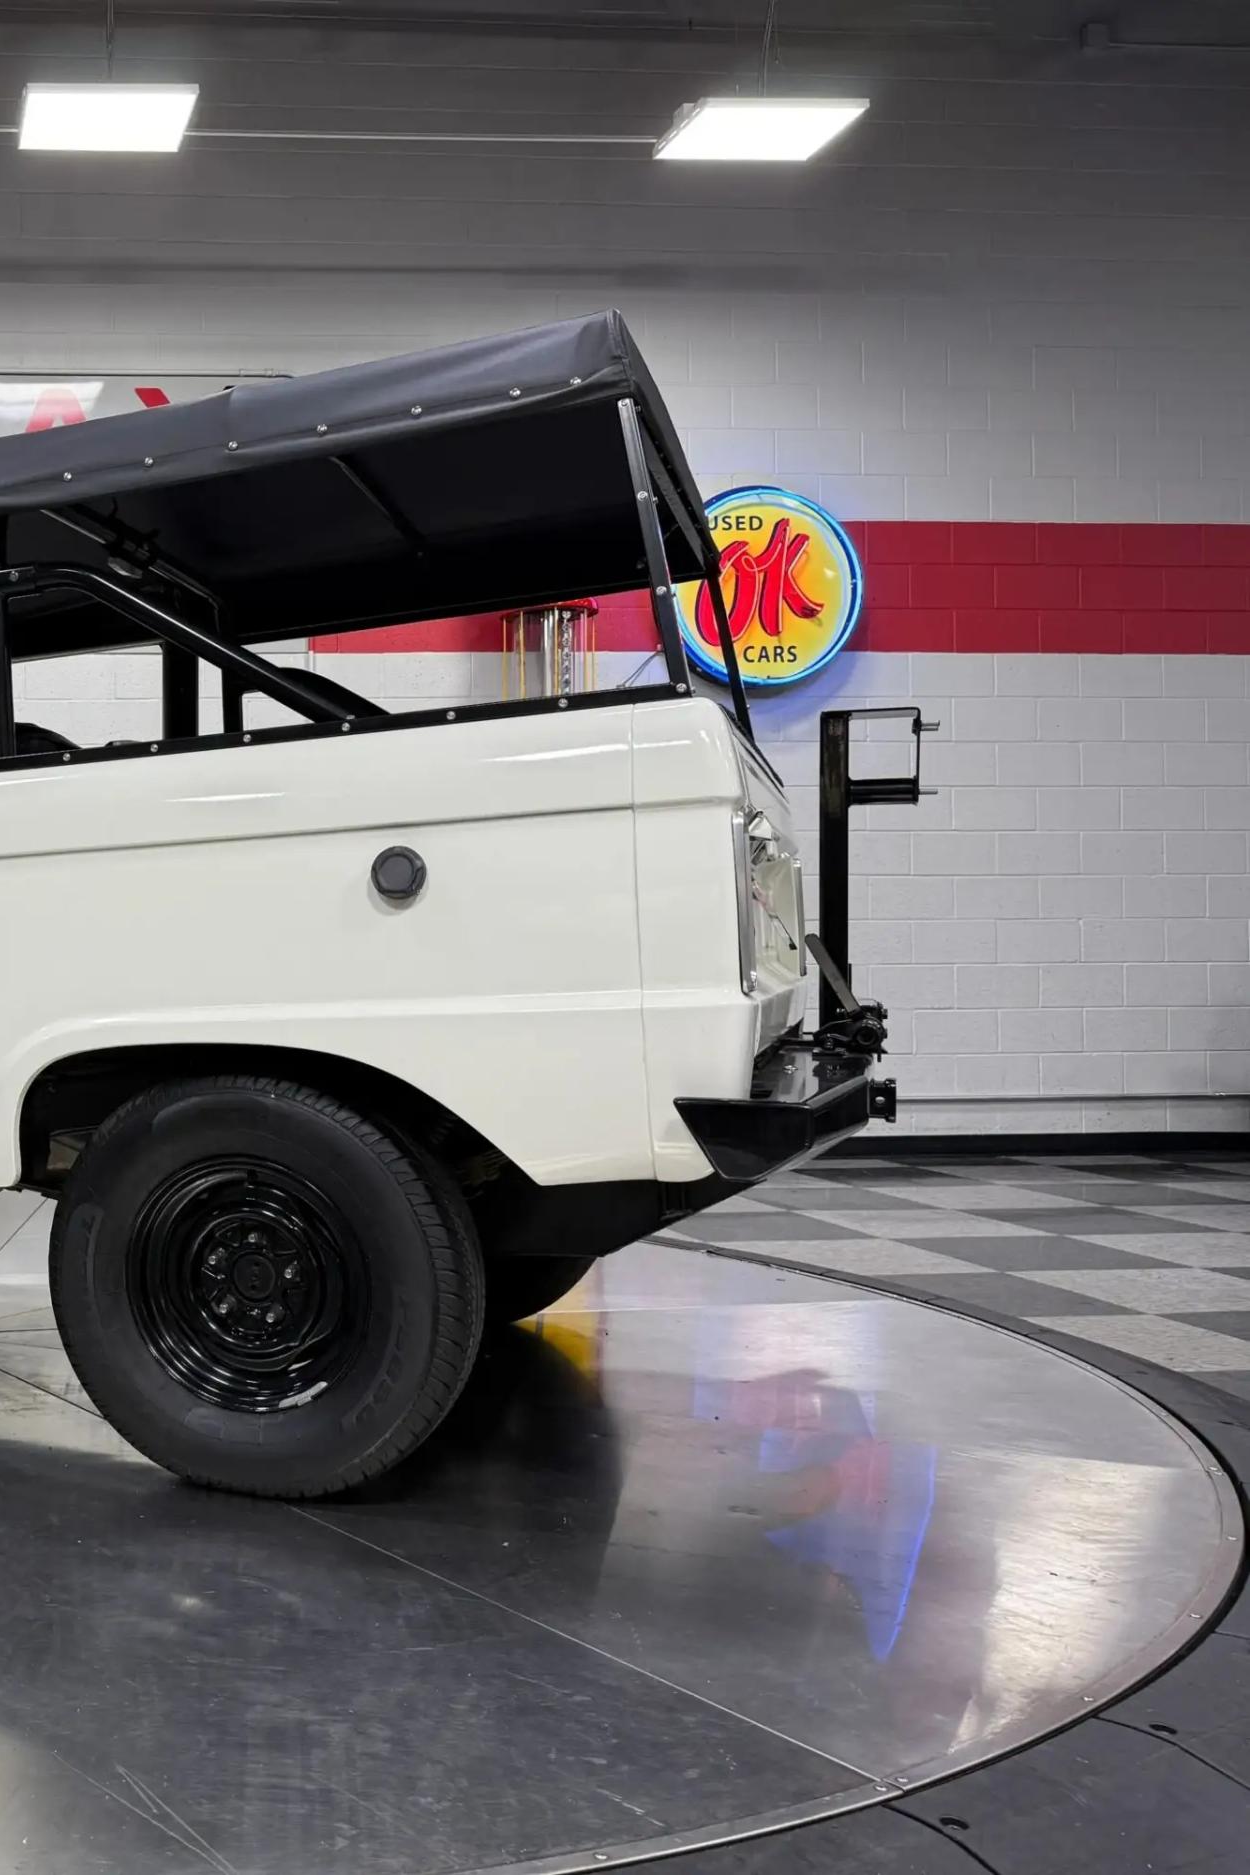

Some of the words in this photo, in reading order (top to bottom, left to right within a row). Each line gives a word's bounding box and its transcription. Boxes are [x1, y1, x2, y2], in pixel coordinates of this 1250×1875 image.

[707, 515, 763, 531] USED
[694, 518, 825, 646] OK
[743, 645, 797, 663] CARS
